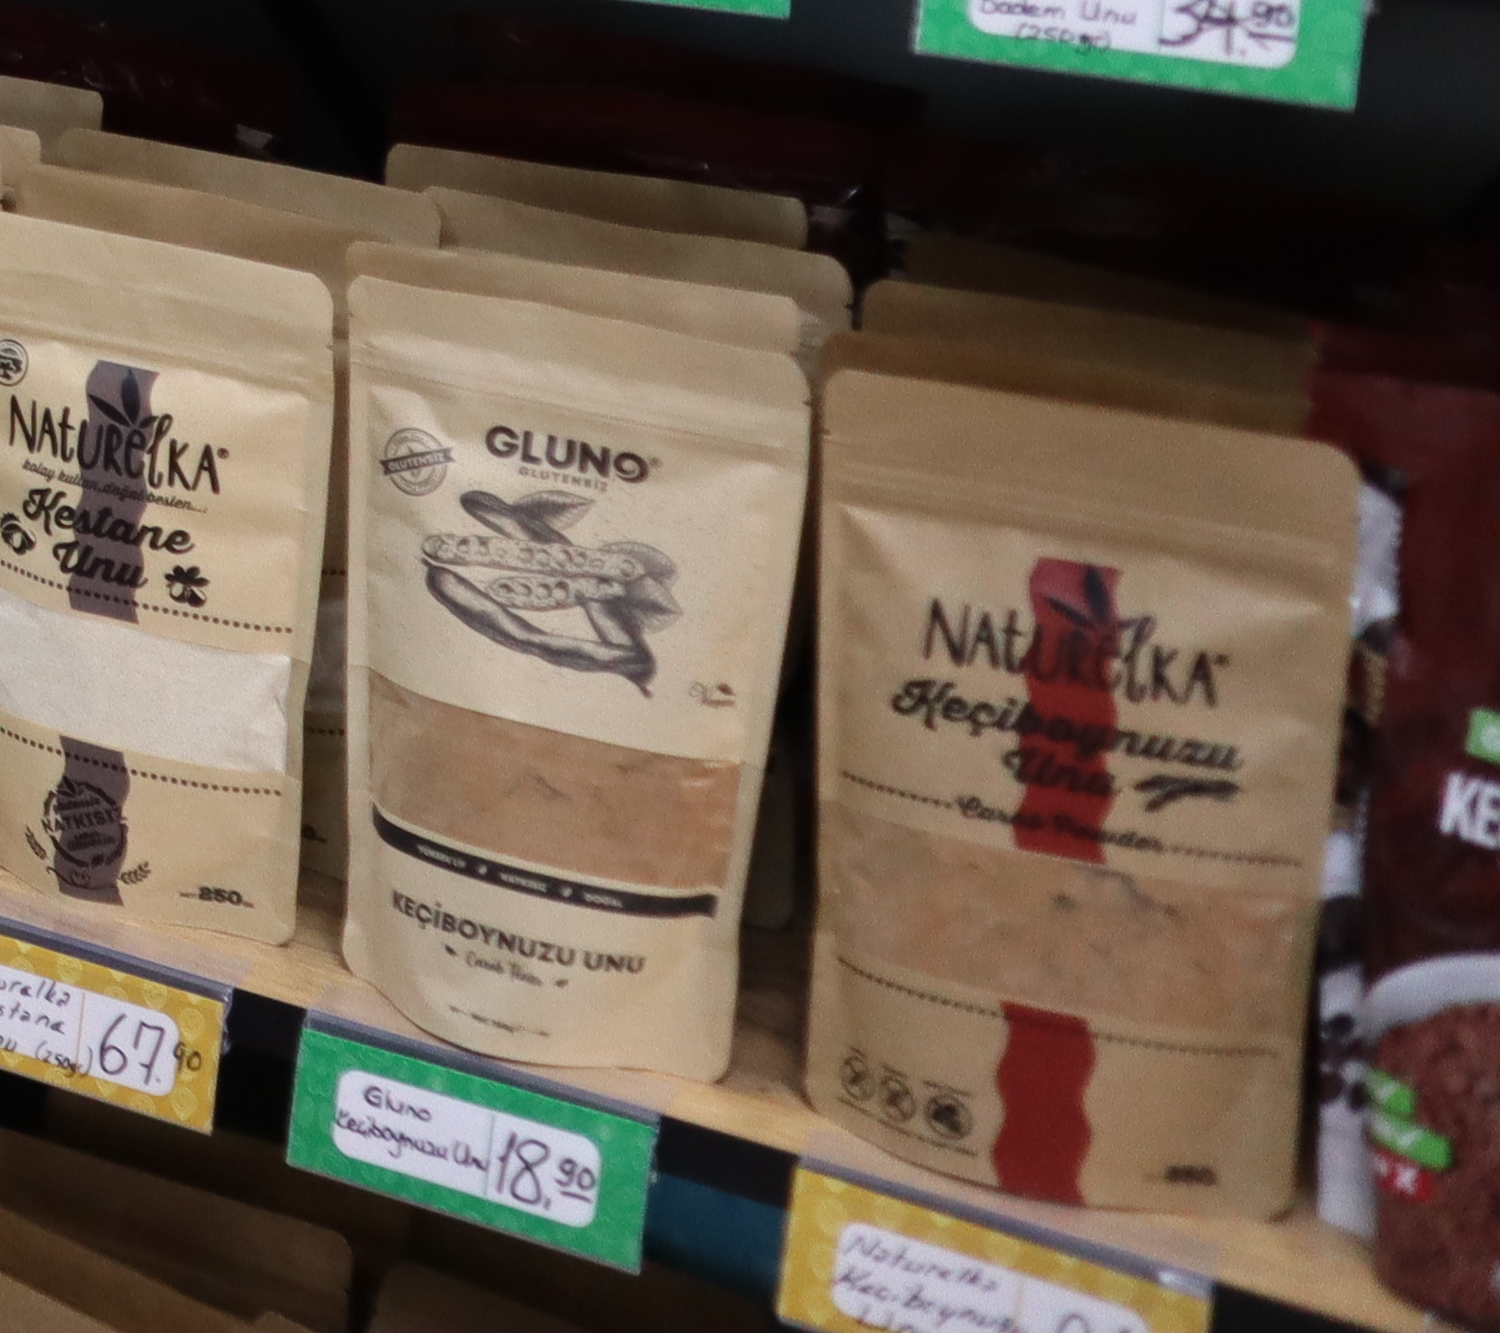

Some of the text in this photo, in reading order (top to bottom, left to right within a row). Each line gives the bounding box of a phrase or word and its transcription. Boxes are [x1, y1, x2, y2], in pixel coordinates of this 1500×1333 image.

[484, 424, 649, 485] GLUNO
[22, 487, 194, 556] Kestane
[51, 539, 149, 592] Unu
[893, 678, 1243, 772] Keçiboynuzu
[391, 890, 645, 977] KEÇİBOYNUZU UNU
[362, 1084, 434, 1125] Gluno
